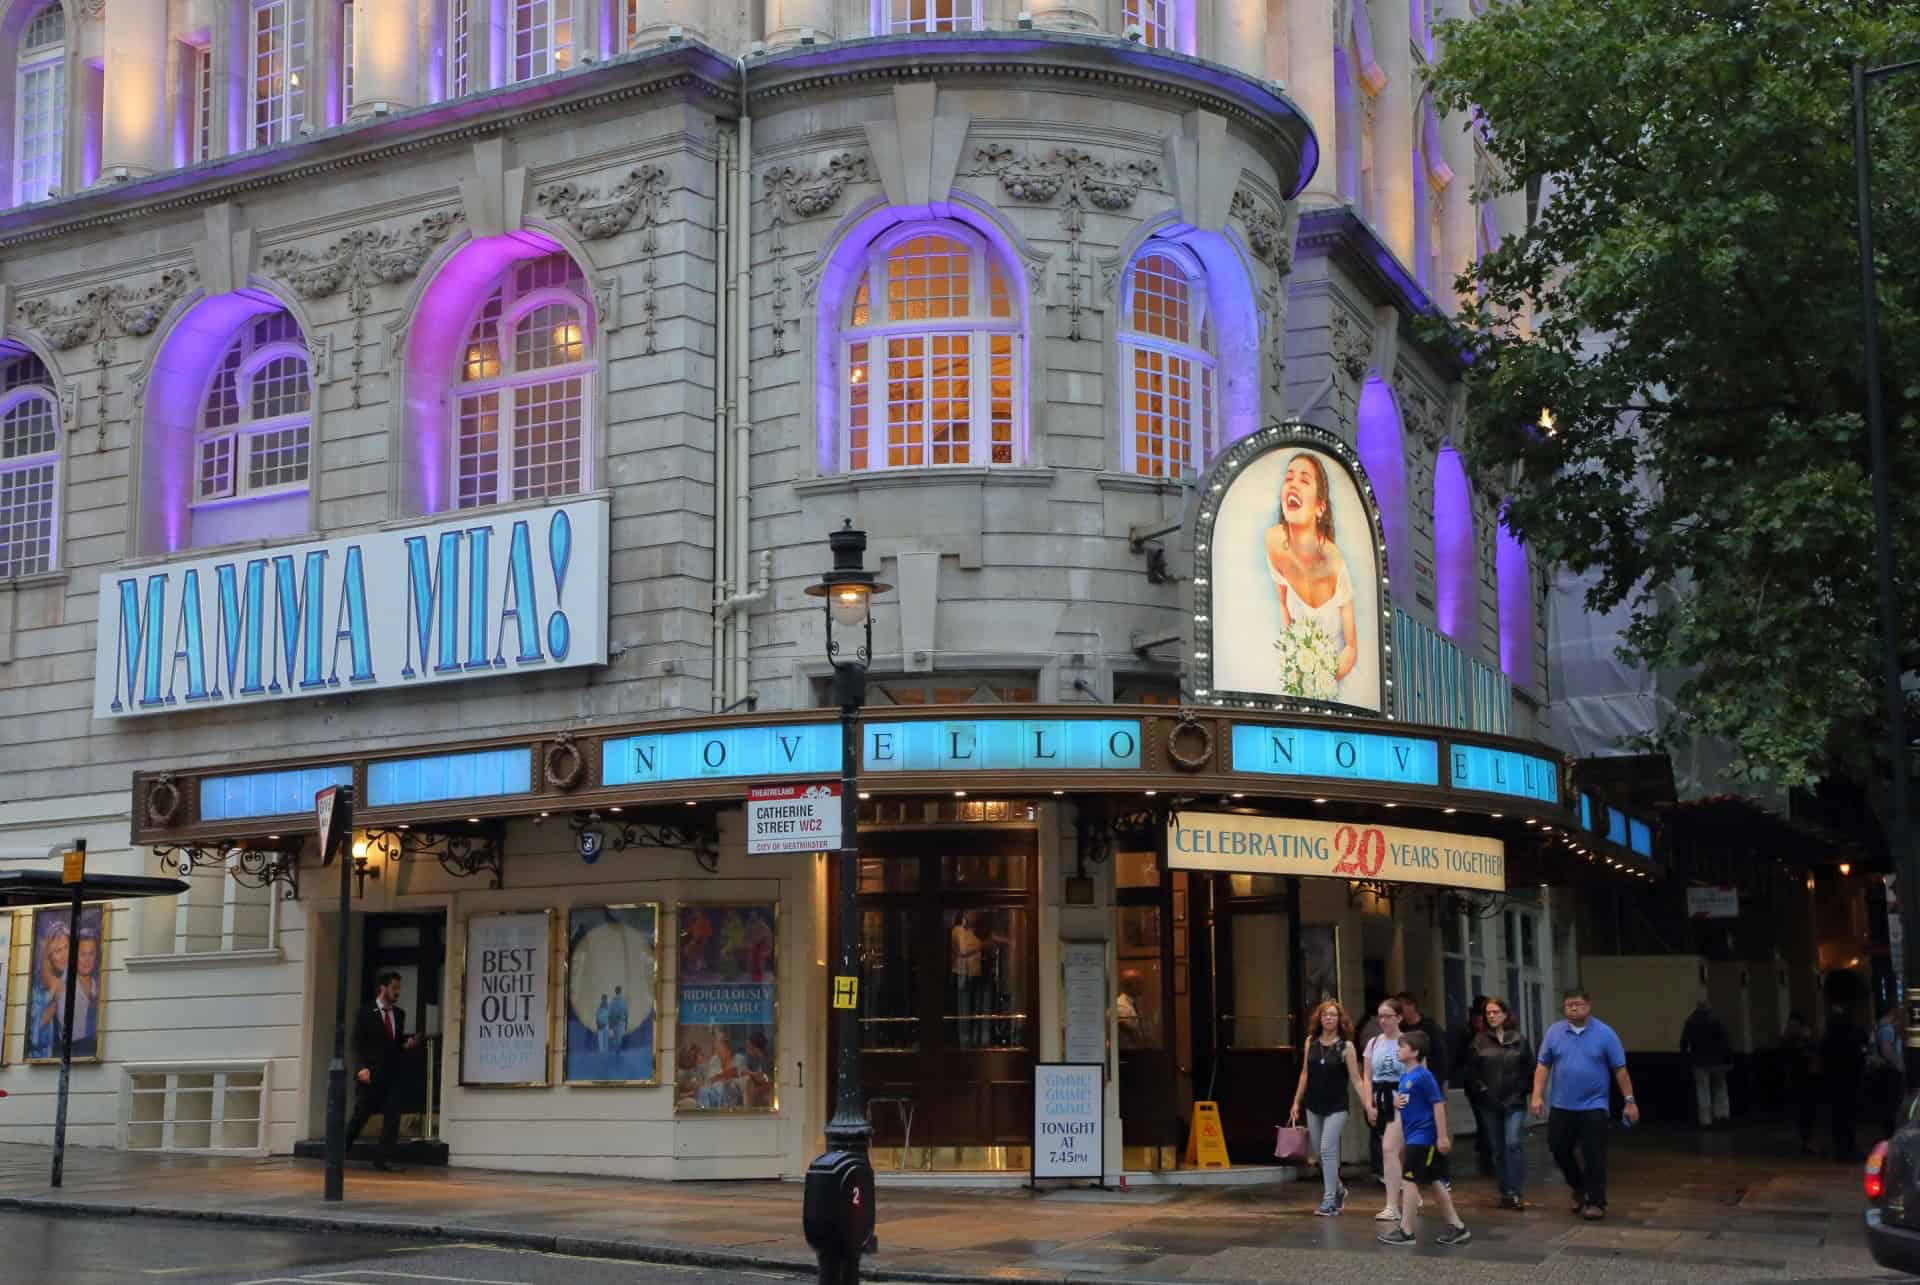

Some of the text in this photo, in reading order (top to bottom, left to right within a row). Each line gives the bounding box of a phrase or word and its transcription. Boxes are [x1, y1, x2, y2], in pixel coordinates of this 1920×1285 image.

[111, 509, 572, 712] MAMMA MIA!
[752, 787, 795, 797] THEATRELAND
[757, 804, 814, 820] CATHERINE
[757, 819, 823, 834] STREET WC2
[756, 840, 829, 852] CITY OF WESTMINSTER
[1176, 824, 1504, 878] CELEBRATING 20 YEARS TOGETHER
[482, 949, 536, 974] BEST
[481, 974, 535, 994] NIGHT
[481, 995, 536, 1023] OUT
[479, 1023, 536, 1039] IN TOWN
[1040, 1122, 1096, 1135] TONIGHT
[1061, 1136, 1075, 1149] AT
[852, 1186, 860, 1204] 2
